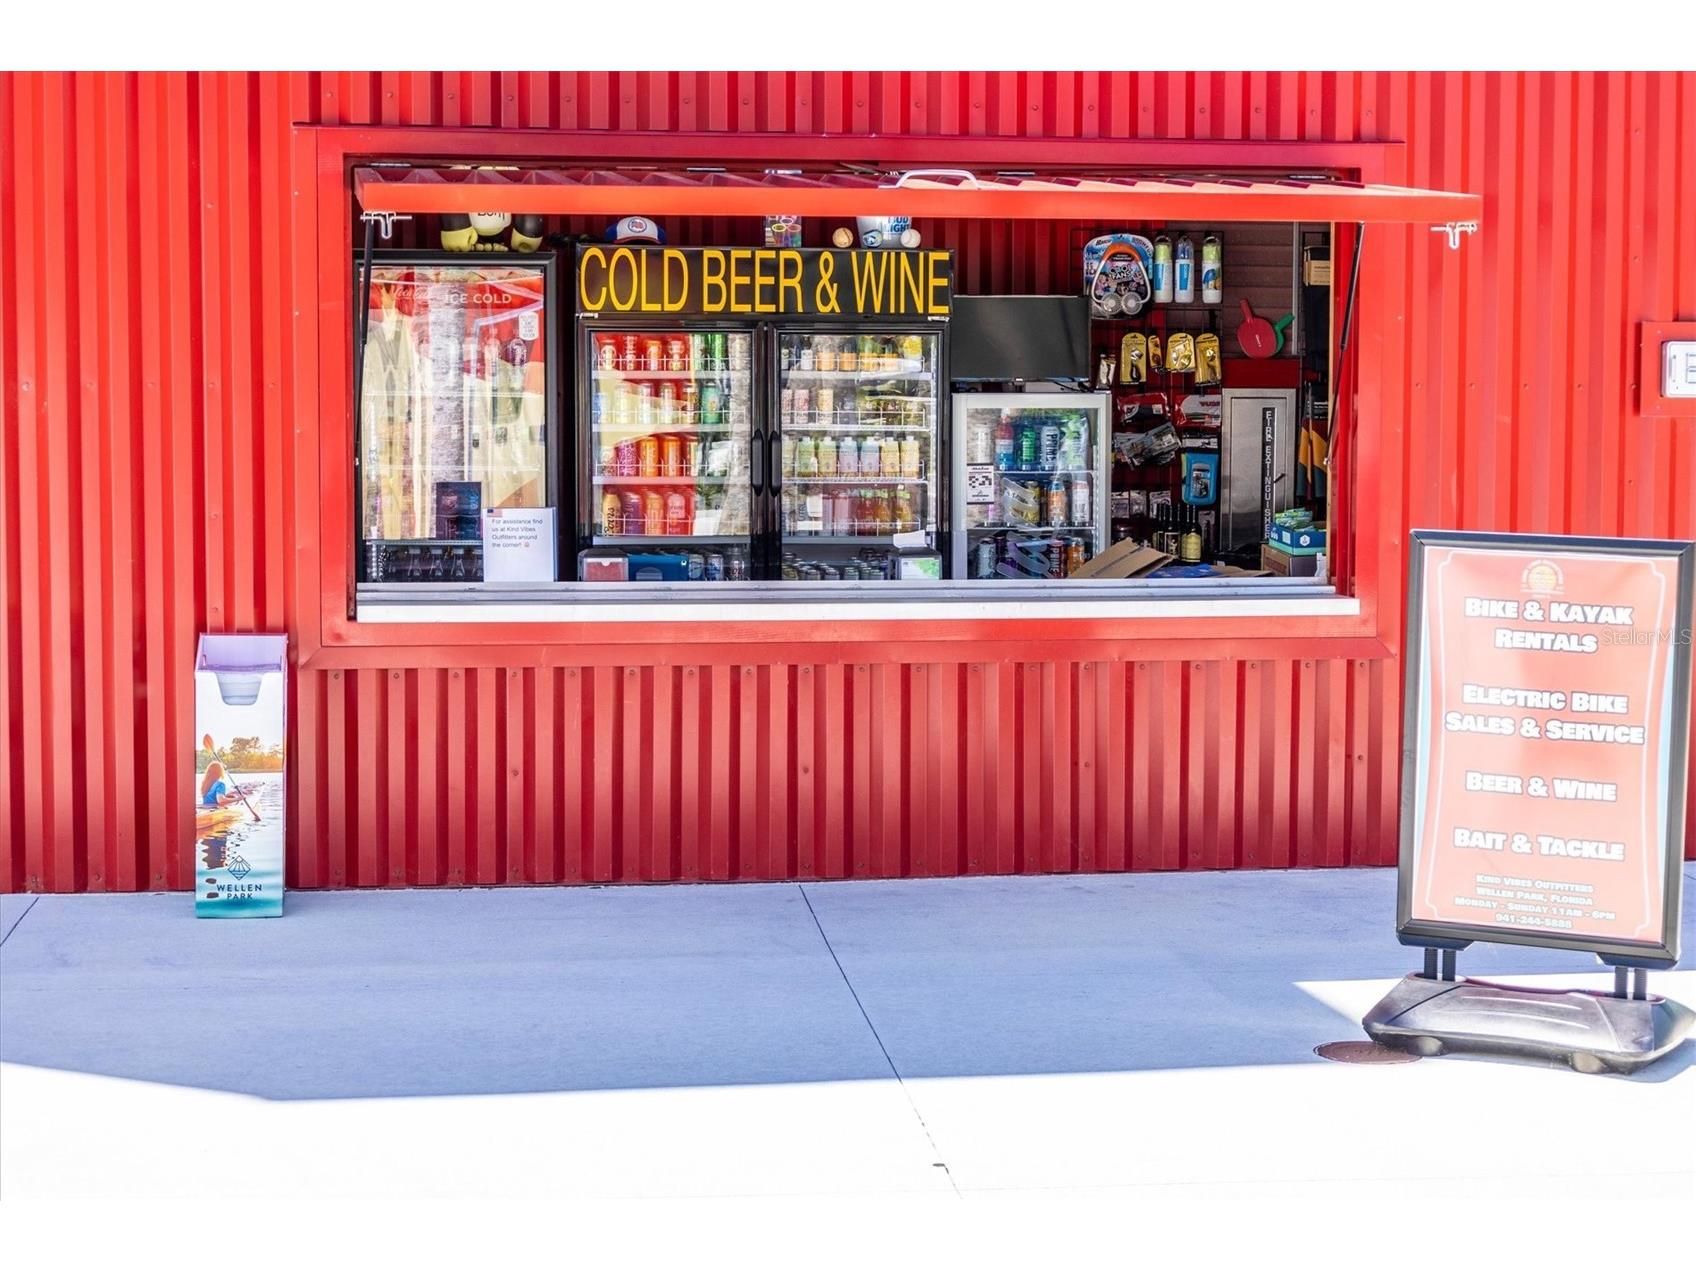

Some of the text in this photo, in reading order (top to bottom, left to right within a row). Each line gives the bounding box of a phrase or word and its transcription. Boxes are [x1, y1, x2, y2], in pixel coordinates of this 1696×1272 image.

[581, 248, 949, 313] COLD BEER & WINE
[444, 293, 512, 304] ICE COLD
[1264, 410, 1273, 540] FIRE EXTINGUISHER
[1464, 597, 1634, 625] BIKE & KAYAK
[1495, 628, 1598, 654] RENTALS
[1462, 683, 1629, 714] ELECTRIC BIKE
[1445, 711, 1646, 745] SALES & SERVICE
[1465, 770, 1618, 802] BEER & WINE
[1453, 827, 1626, 862] BAIT & TACKLE
[216, 884, 262, 892] WELLEN
[1476, 874, 1502, 885] KIND
[1503, 877, 1533, 888] VIBES
[227, 892, 253, 900] PARK
[1454, 896, 1498, 909] MONDAY
[1507, 902, 1550, 915] SUNDAY
[1476, 886, 1514, 899] WELLEN
[1550, 893, 1593, 906] FLORIDA
